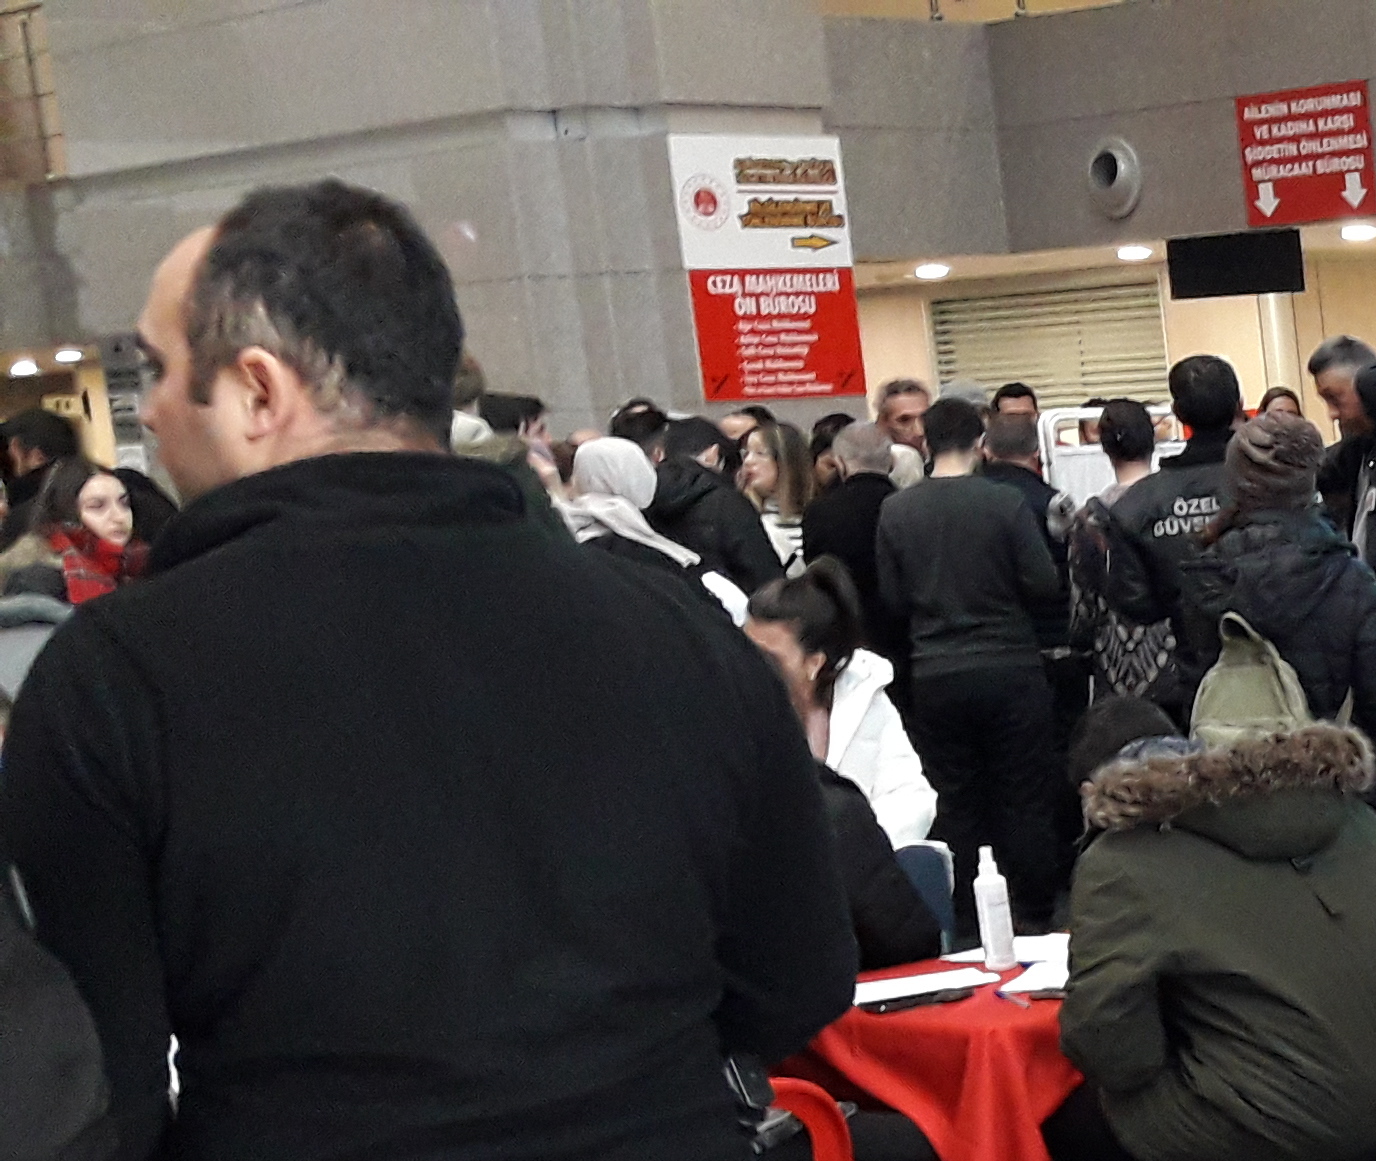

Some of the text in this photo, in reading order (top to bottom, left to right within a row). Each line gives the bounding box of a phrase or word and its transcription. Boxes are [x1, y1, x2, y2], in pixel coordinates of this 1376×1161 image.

[1253, 124, 1270, 140] VE
[1271, 118, 1316, 139] KADINA
[707, 274, 742, 295] CEZA
[1173, 496, 1221, 517] ÖZEL
